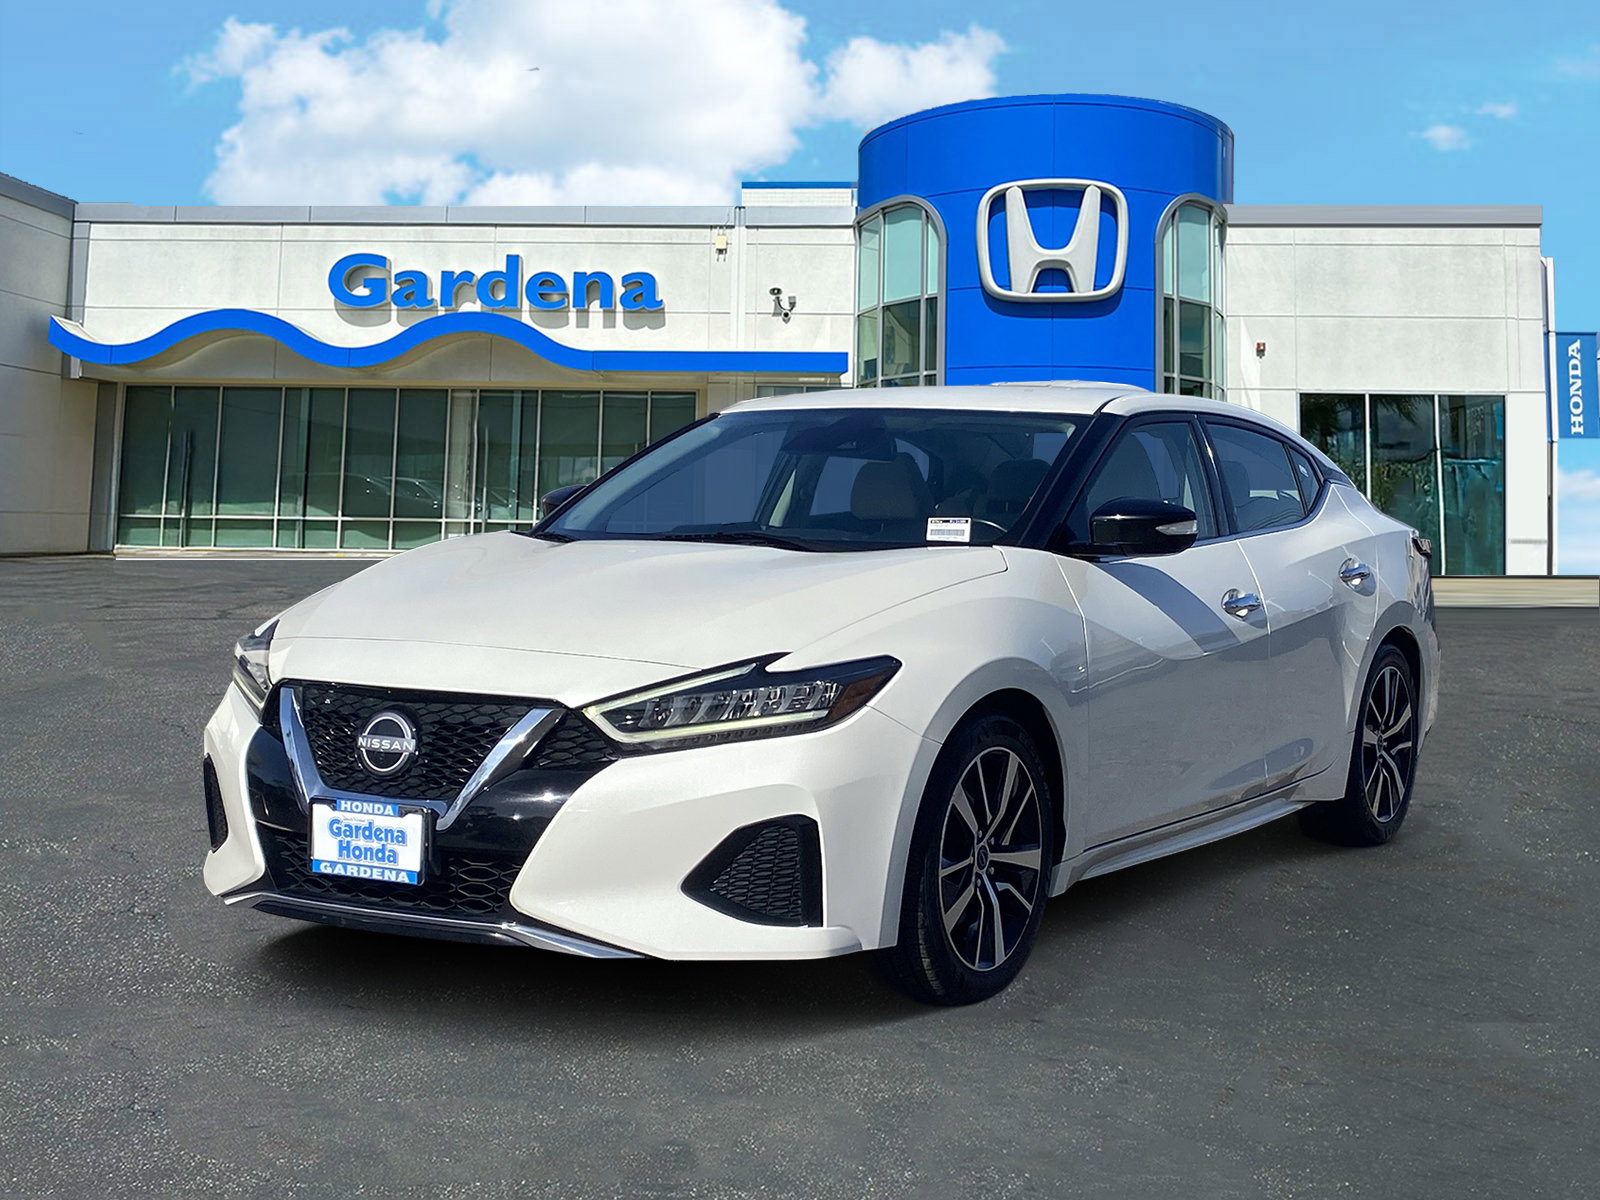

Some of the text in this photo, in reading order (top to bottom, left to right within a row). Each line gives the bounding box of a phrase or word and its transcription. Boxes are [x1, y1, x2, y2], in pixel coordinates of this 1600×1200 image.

[328, 253, 664, 310] Gardena
[1568, 339, 1584, 435] HONDA
[358, 736, 413, 751] NISSAN
[340, 800, 394, 816] HONDA
[328, 818, 406, 845] Gardena
[337, 839, 397, 864] Honda
[319, 862, 409, 883] GARDENA
